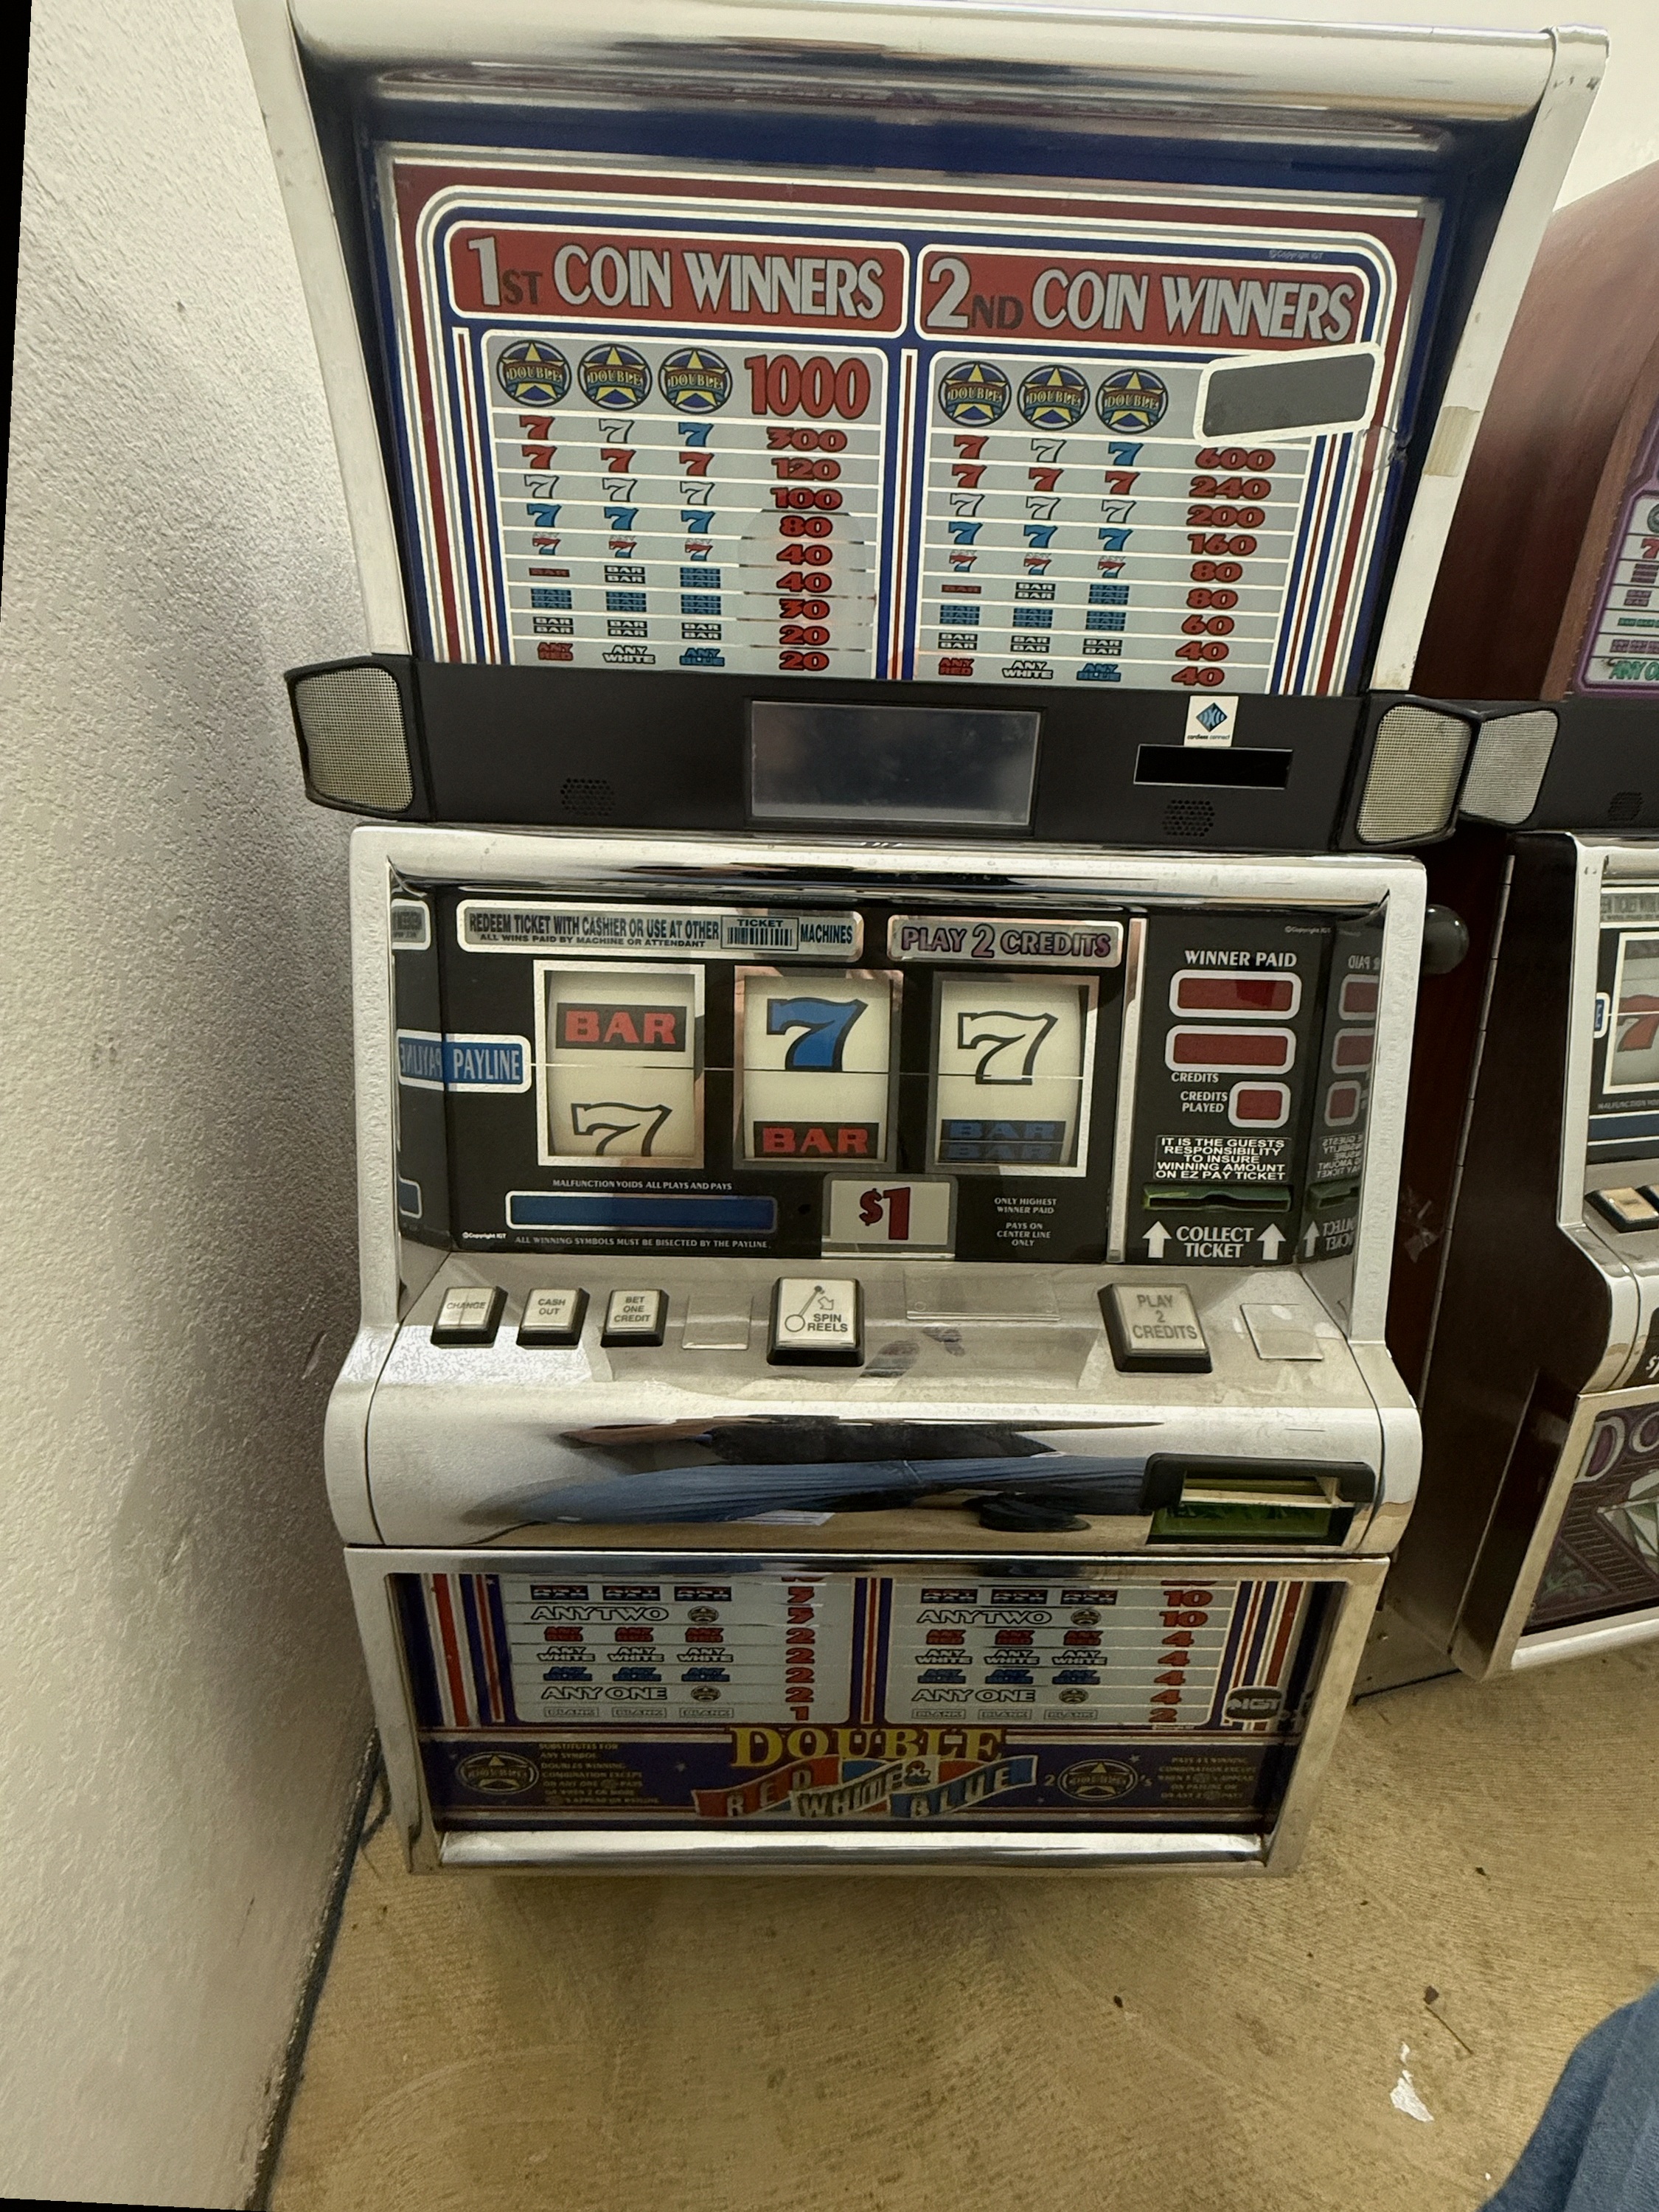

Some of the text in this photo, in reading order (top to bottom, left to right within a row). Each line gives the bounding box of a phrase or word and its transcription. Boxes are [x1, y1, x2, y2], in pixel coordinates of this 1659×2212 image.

[467, 236, 884, 319] 1ST COIN WINNERS
[925, 257, 1357, 343] 2ND COIN WINNERS
[507, 354, 872, 420] DOUBLE DOUBLE DOUBLE 1000
[949, 386, 1160, 411] DOUBLE DOUBLE DOUBLE
[766, 426, 848, 453] 300
[1194, 447, 1276, 471] 600
[771, 457, 841, 481] 120
[1189, 475, 1272, 500] 240
[770, 487, 843, 510] 100
[1186, 504, 1266, 529] 200
[779, 515, 833, 539] 80
[1187, 532, 1258, 557] 160
[776, 543, 833, 566] 40
[1190, 560, 1243, 583] 80
[776, 571, 832, 594] 40
[1186, 588, 1239, 610] 80
[779, 598, 831, 620] 30
[1181, 613, 1235, 636] 60
[779, 625, 831, 646] 20
[602, 653, 655, 664] WHITE
[612, 644, 830, 672] ANY 20
[1175, 640, 1229, 661] 40
[1002, 667, 1054, 679] WHITE
[1012, 660, 1225, 687] ANY 40
[469, 913, 853, 945] REDEEM TICKET WITH CASHIER OR USE AT OTHER TICKET MACHINES
[501, 934, 529, 942] WINS
[532, 935, 557, 943] PAID
[559, 936, 573, 944] BY
[576, 936, 625, 945] MACHINE
[627, 938, 642, 946] OR
[644, 939, 706, 948] ATTENDANT
[901, 923, 1112, 959] PLAY 2 CREDITS
[1184, 950, 1298, 968] WINNER PAID
[566, 997, 1059, 1085] BAR 7 7
[452, 1048, 521, 1081] PAYLINE
[1171, 1072, 1220, 1083] CREDITS
[1180, 1091, 1228, 1102] CREDITS
[1181, 1102, 1225, 1113] PLAYED
[571, 1102, 1057, 1156] 7 BAR BAR
[1161, 1137, 1285, 1149] IT IS THE GUESTS
[1164, 1146, 1281, 1156] RESPONSIBILITY
[1157, 1162, 1285, 1172] WINNING AMOUNT
[1183, 1155, 1260, 1164] TO INSURE
[1155, 1170, 1286, 1180] ON EZ PAY TICKET
[552, 1179, 732, 1191] MALFUNCTION VOIDS ALL PLAYS AND PAYS
[994, 1197, 1058, 1206] ONLY HIGHEST
[996, 1206, 1054, 1214] WINNER PAID
[859, 1186, 911, 1240] $1
[996, 1230, 1051, 1239] CENTER LINE
[1005, 1222, 1043, 1231] PAYS ON
[1176, 1226, 1254, 1242] COLLECT
[533, 1237, 573, 1245] WINNING
[616, 1238, 639, 1246] MUST
[655, 1239, 698, 1247] BISECTED
[1011, 1239, 1034, 1247] ONLY
[1183, 1242, 1245, 1259] TICKET
[446, 1301, 487, 1310] CHANGE
[538, 1298, 566, 1307] CASH
[1136, 1294, 1173, 1308] PLAY
[613, 1315, 651, 1323] CREDIT
[813, 1313, 842, 1323] SPIN
[1155, 1310, 1166, 1323] 2
[807, 1322, 848, 1332] REELS
[1132, 1325, 1198, 1340] CREDITS
[1163, 1590, 1214, 1607] 10
[1159, 1610, 1208, 1627] 10
[785, 1627, 815, 1644] 2
[1161, 1630, 1195, 1647] 4
[785, 1647, 815, 1664] 2
[916, 1656, 973, 1664] WHITE
[926, 1649, 1190, 1666] ANY 4
[785, 1667, 815, 1683] 2
[1153, 1669, 1186, 1686] 4
[541, 1686, 815, 1703] ANY ONE 2
[911, 1688, 1182, 1705] ANY ONE 4
[790, 1705, 809, 1721] 1
[1148, 1707, 1178, 1723] 2
[728, 1727, 1005, 1768] DOUBLE
[801, 1760, 931, 1817] WHITE &
[1043, 1774, 1056, 1787] 2
[726, 1770, 812, 1816] RED
[910, 1767, 1011, 1818] BLUE
